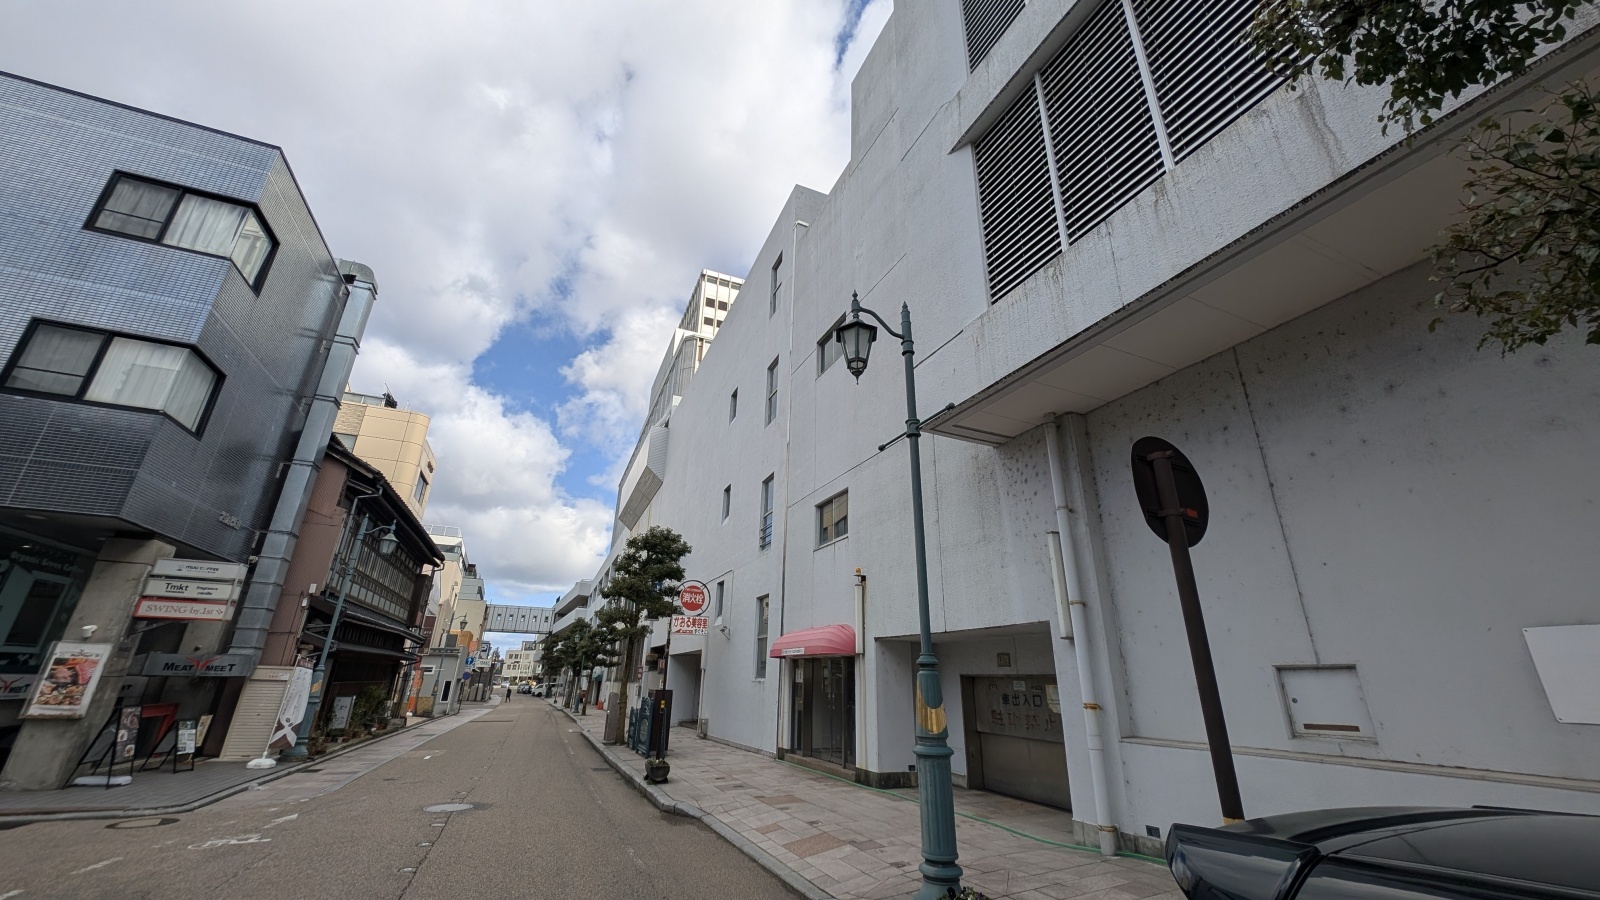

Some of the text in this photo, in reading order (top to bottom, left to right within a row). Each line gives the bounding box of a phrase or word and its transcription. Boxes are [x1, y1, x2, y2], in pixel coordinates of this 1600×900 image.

[165, 582, 189, 591] Tmkt
[682, 593, 704, 604] 消火栓
[145, 604, 187, 613] SWING
[162, 662, 236, 672] MEAT MEET
[1002, 693, 1042, 707] 車出入口
